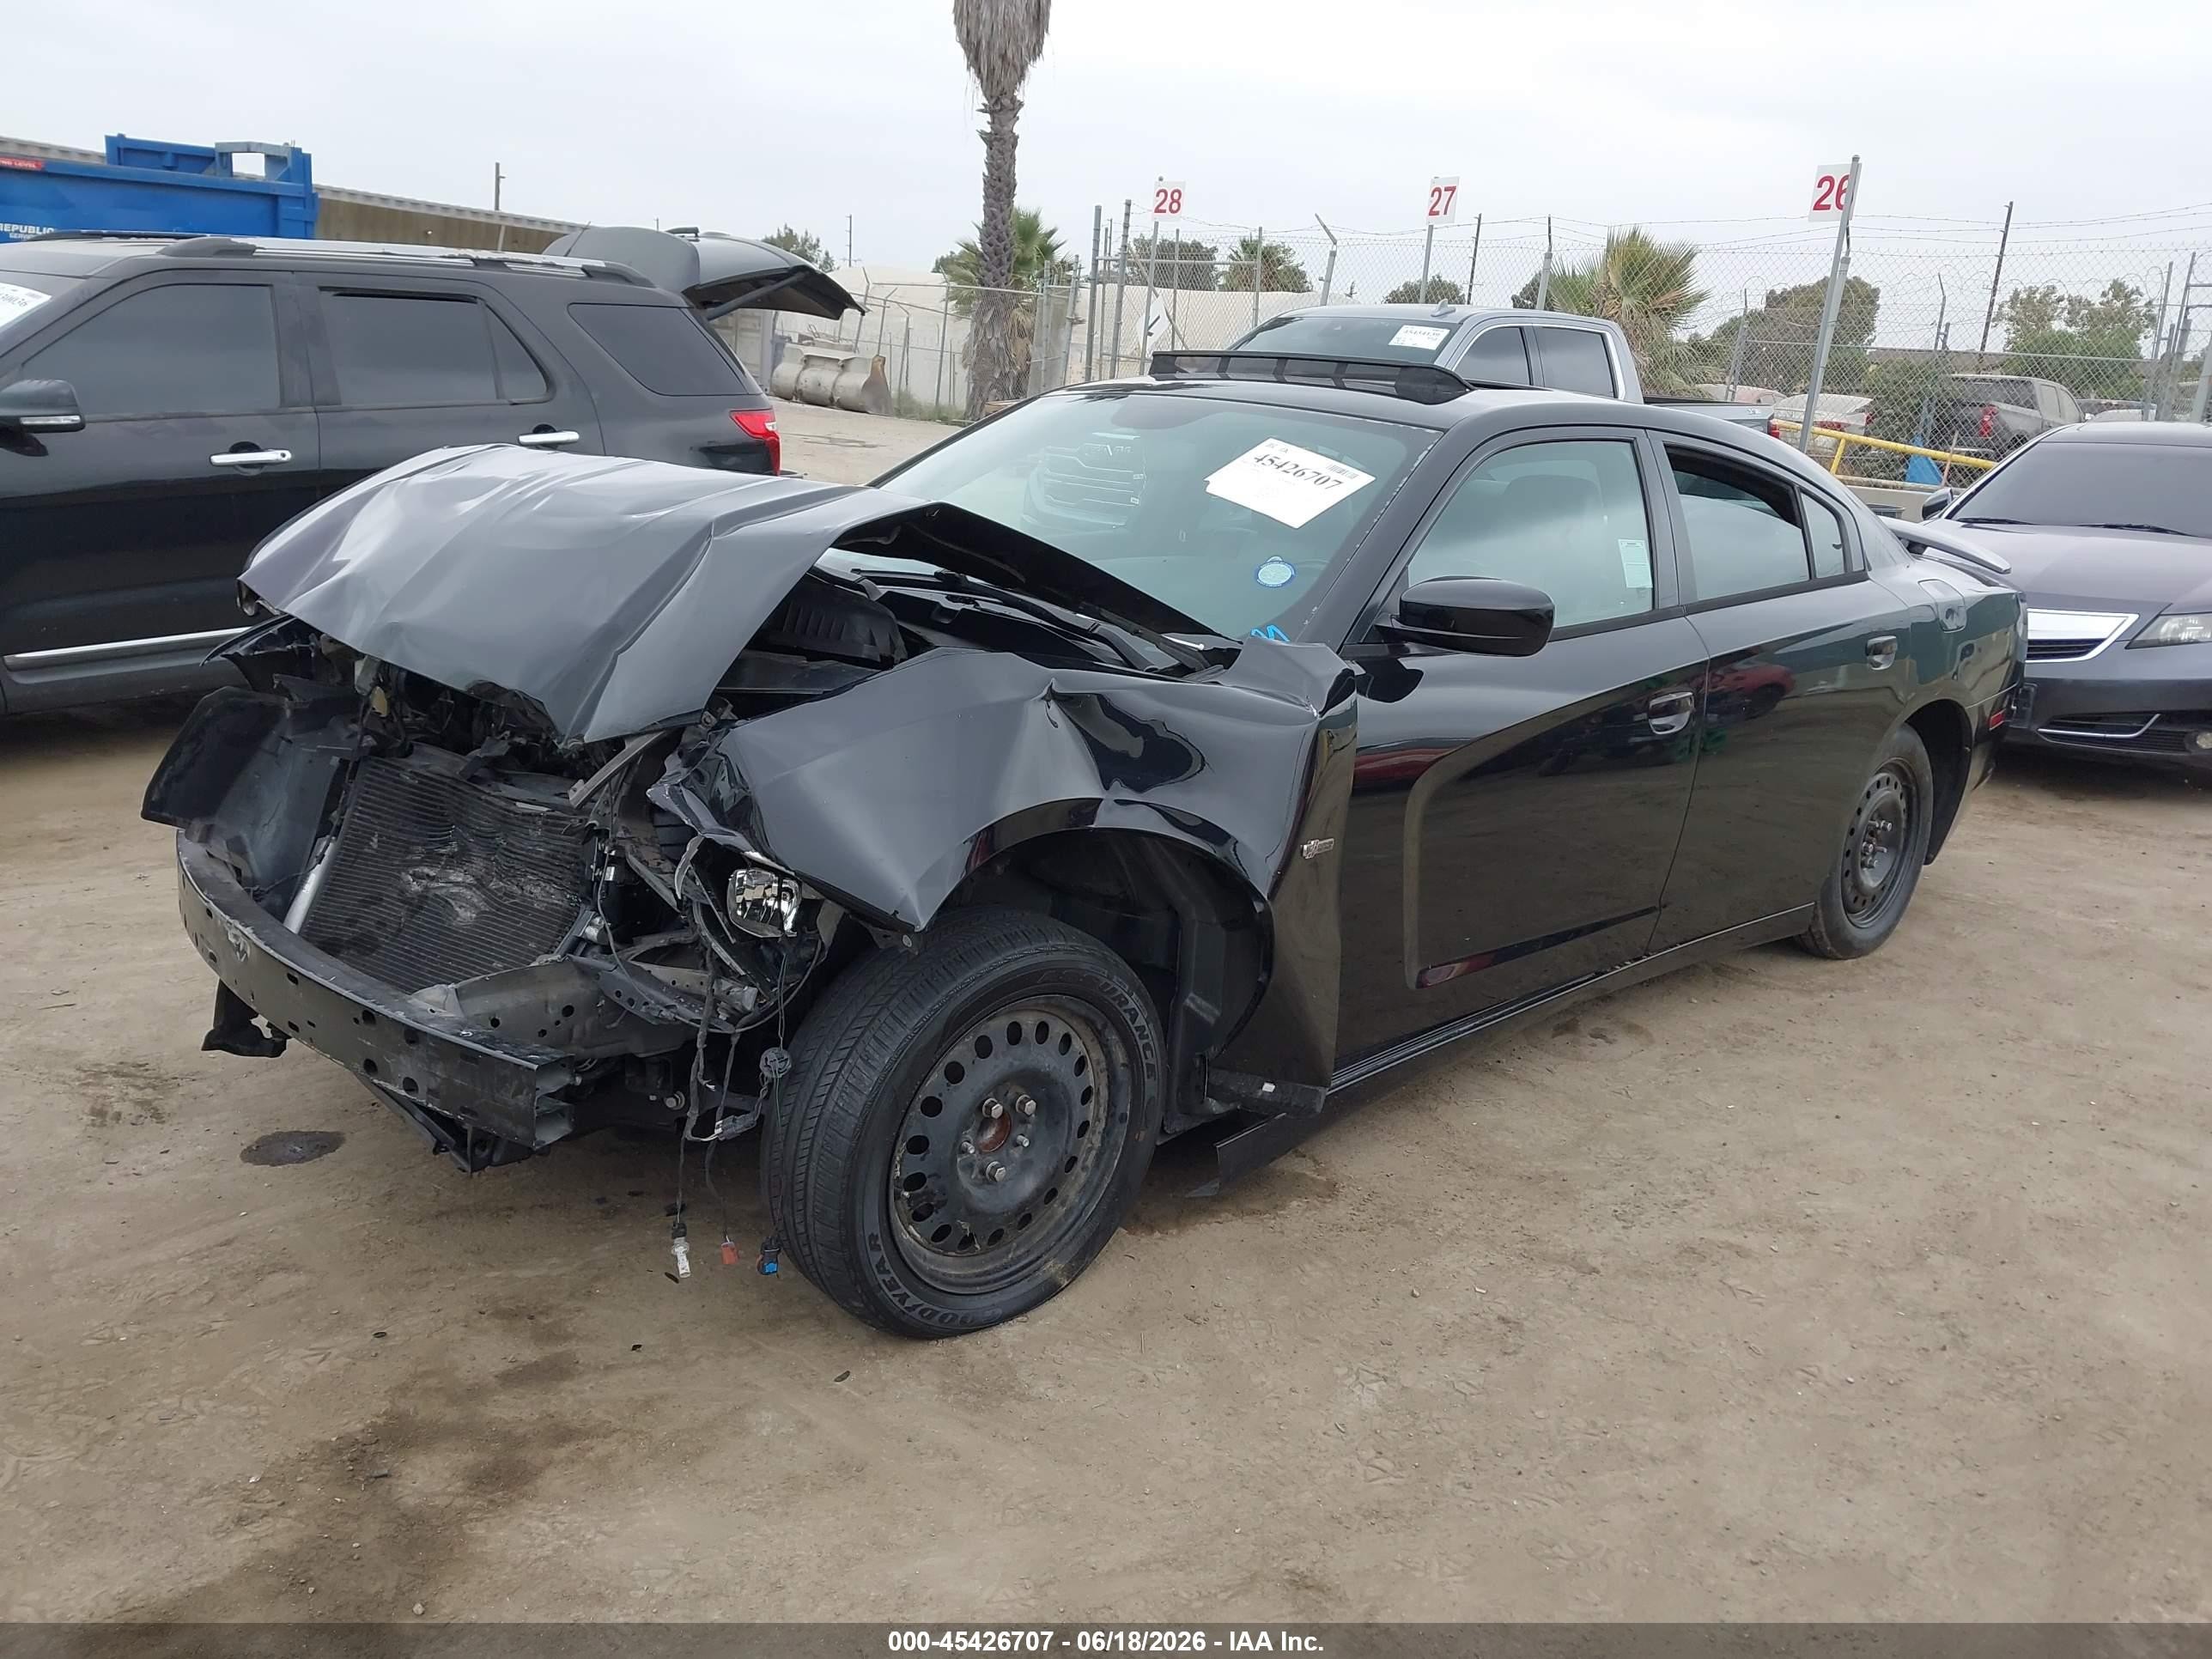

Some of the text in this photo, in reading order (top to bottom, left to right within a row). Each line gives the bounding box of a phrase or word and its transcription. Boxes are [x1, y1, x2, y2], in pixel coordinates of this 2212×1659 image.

[1153, 187, 1182, 215] 28
[1428, 185, 1457, 216] 27
[1253, 453, 1345, 490] 45426707
